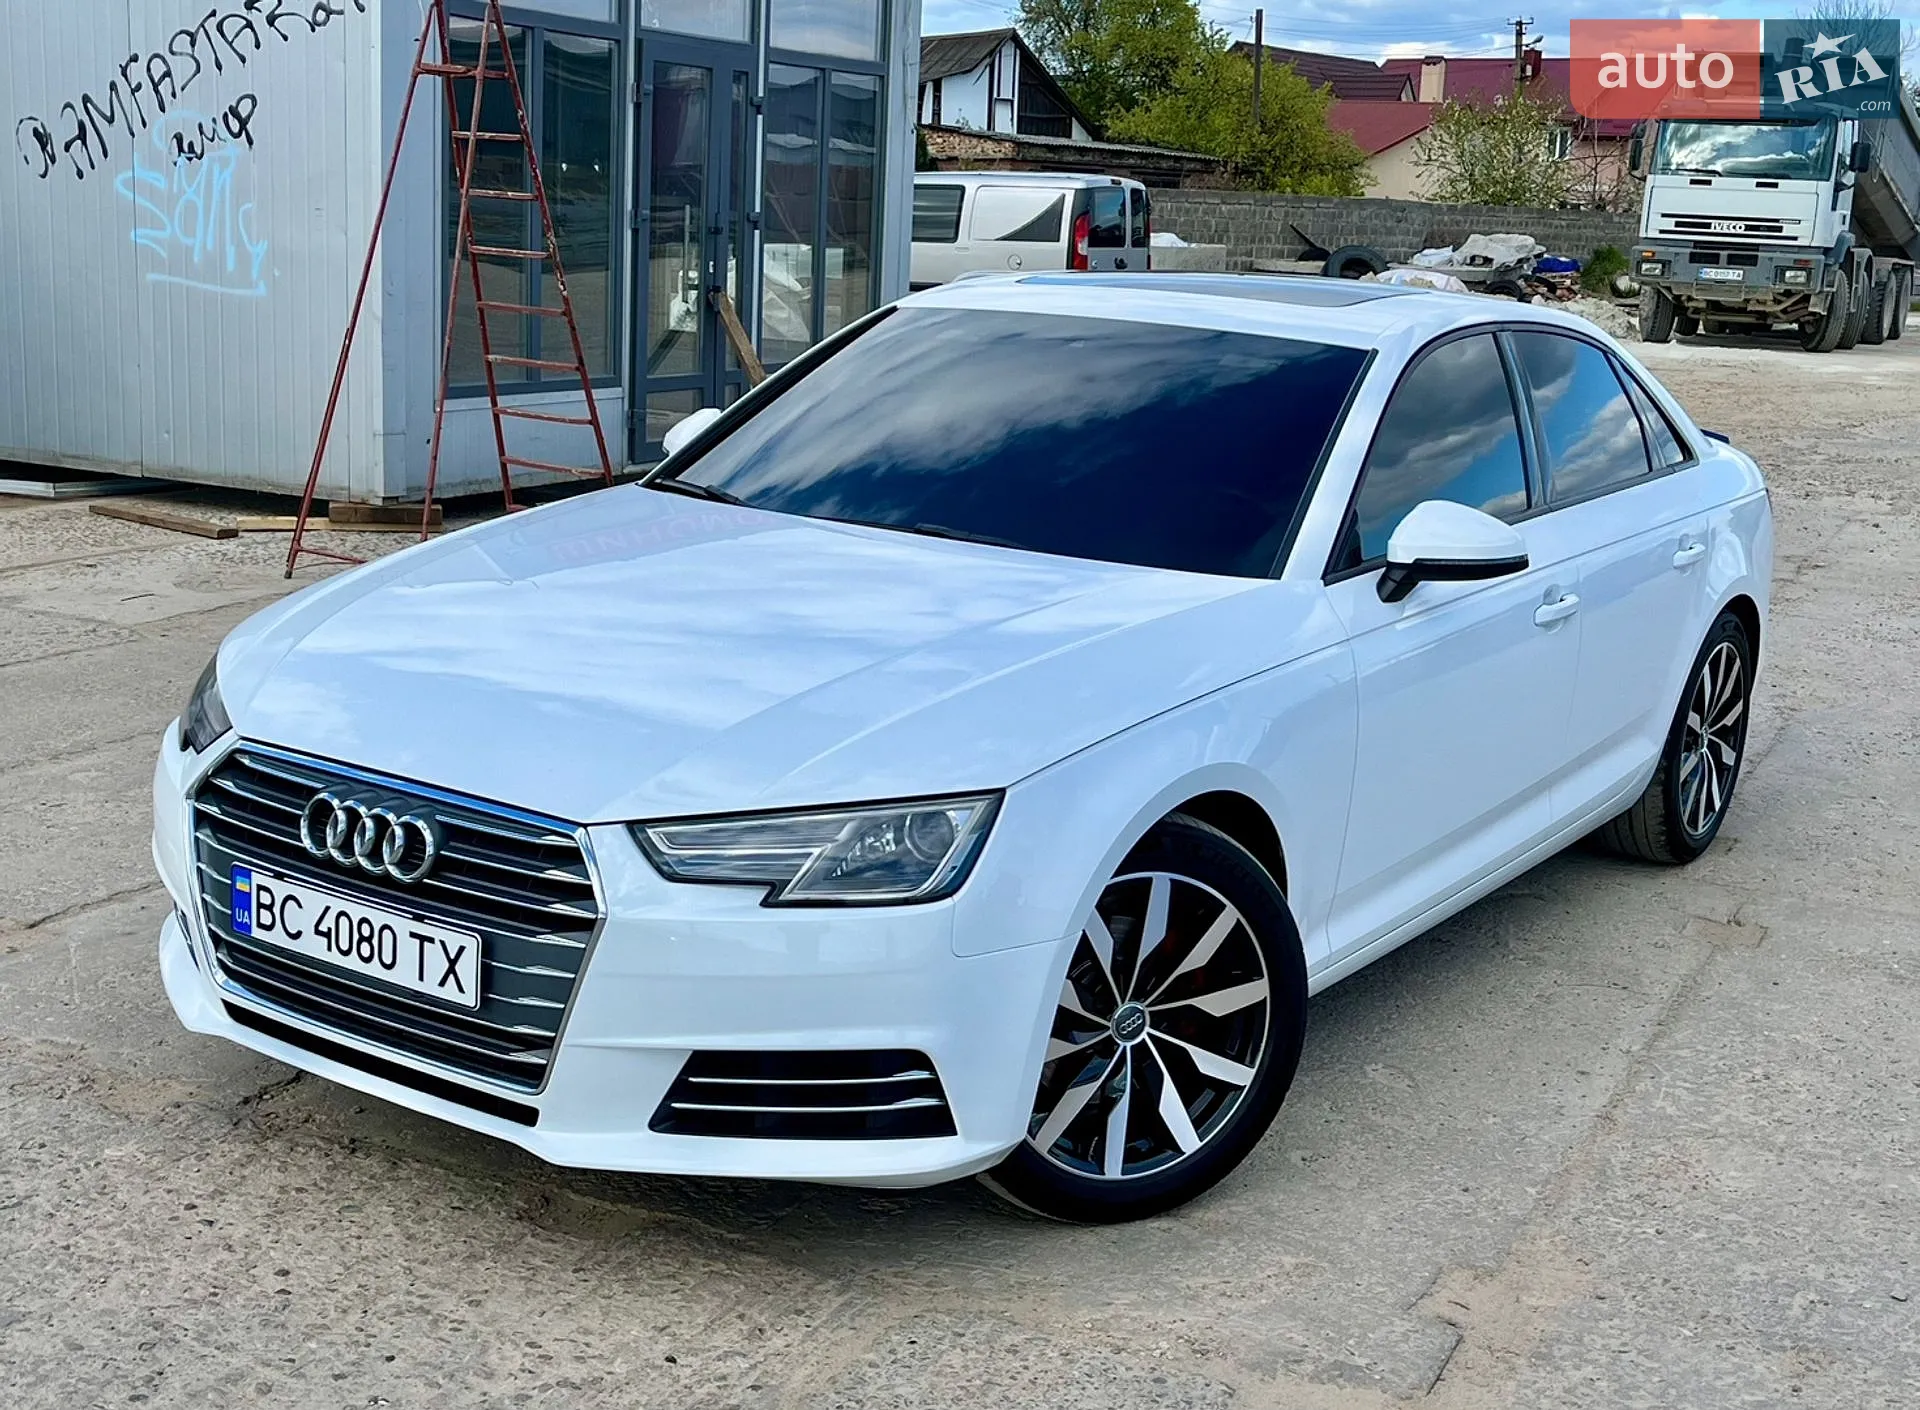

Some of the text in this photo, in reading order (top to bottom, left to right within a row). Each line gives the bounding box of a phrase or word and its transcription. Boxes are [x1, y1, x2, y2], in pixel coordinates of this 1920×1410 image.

[1711, 222, 1745, 232] IVECO
[235, 908, 250, 924] UA
[256, 884, 466, 994] BC 4080 TX
